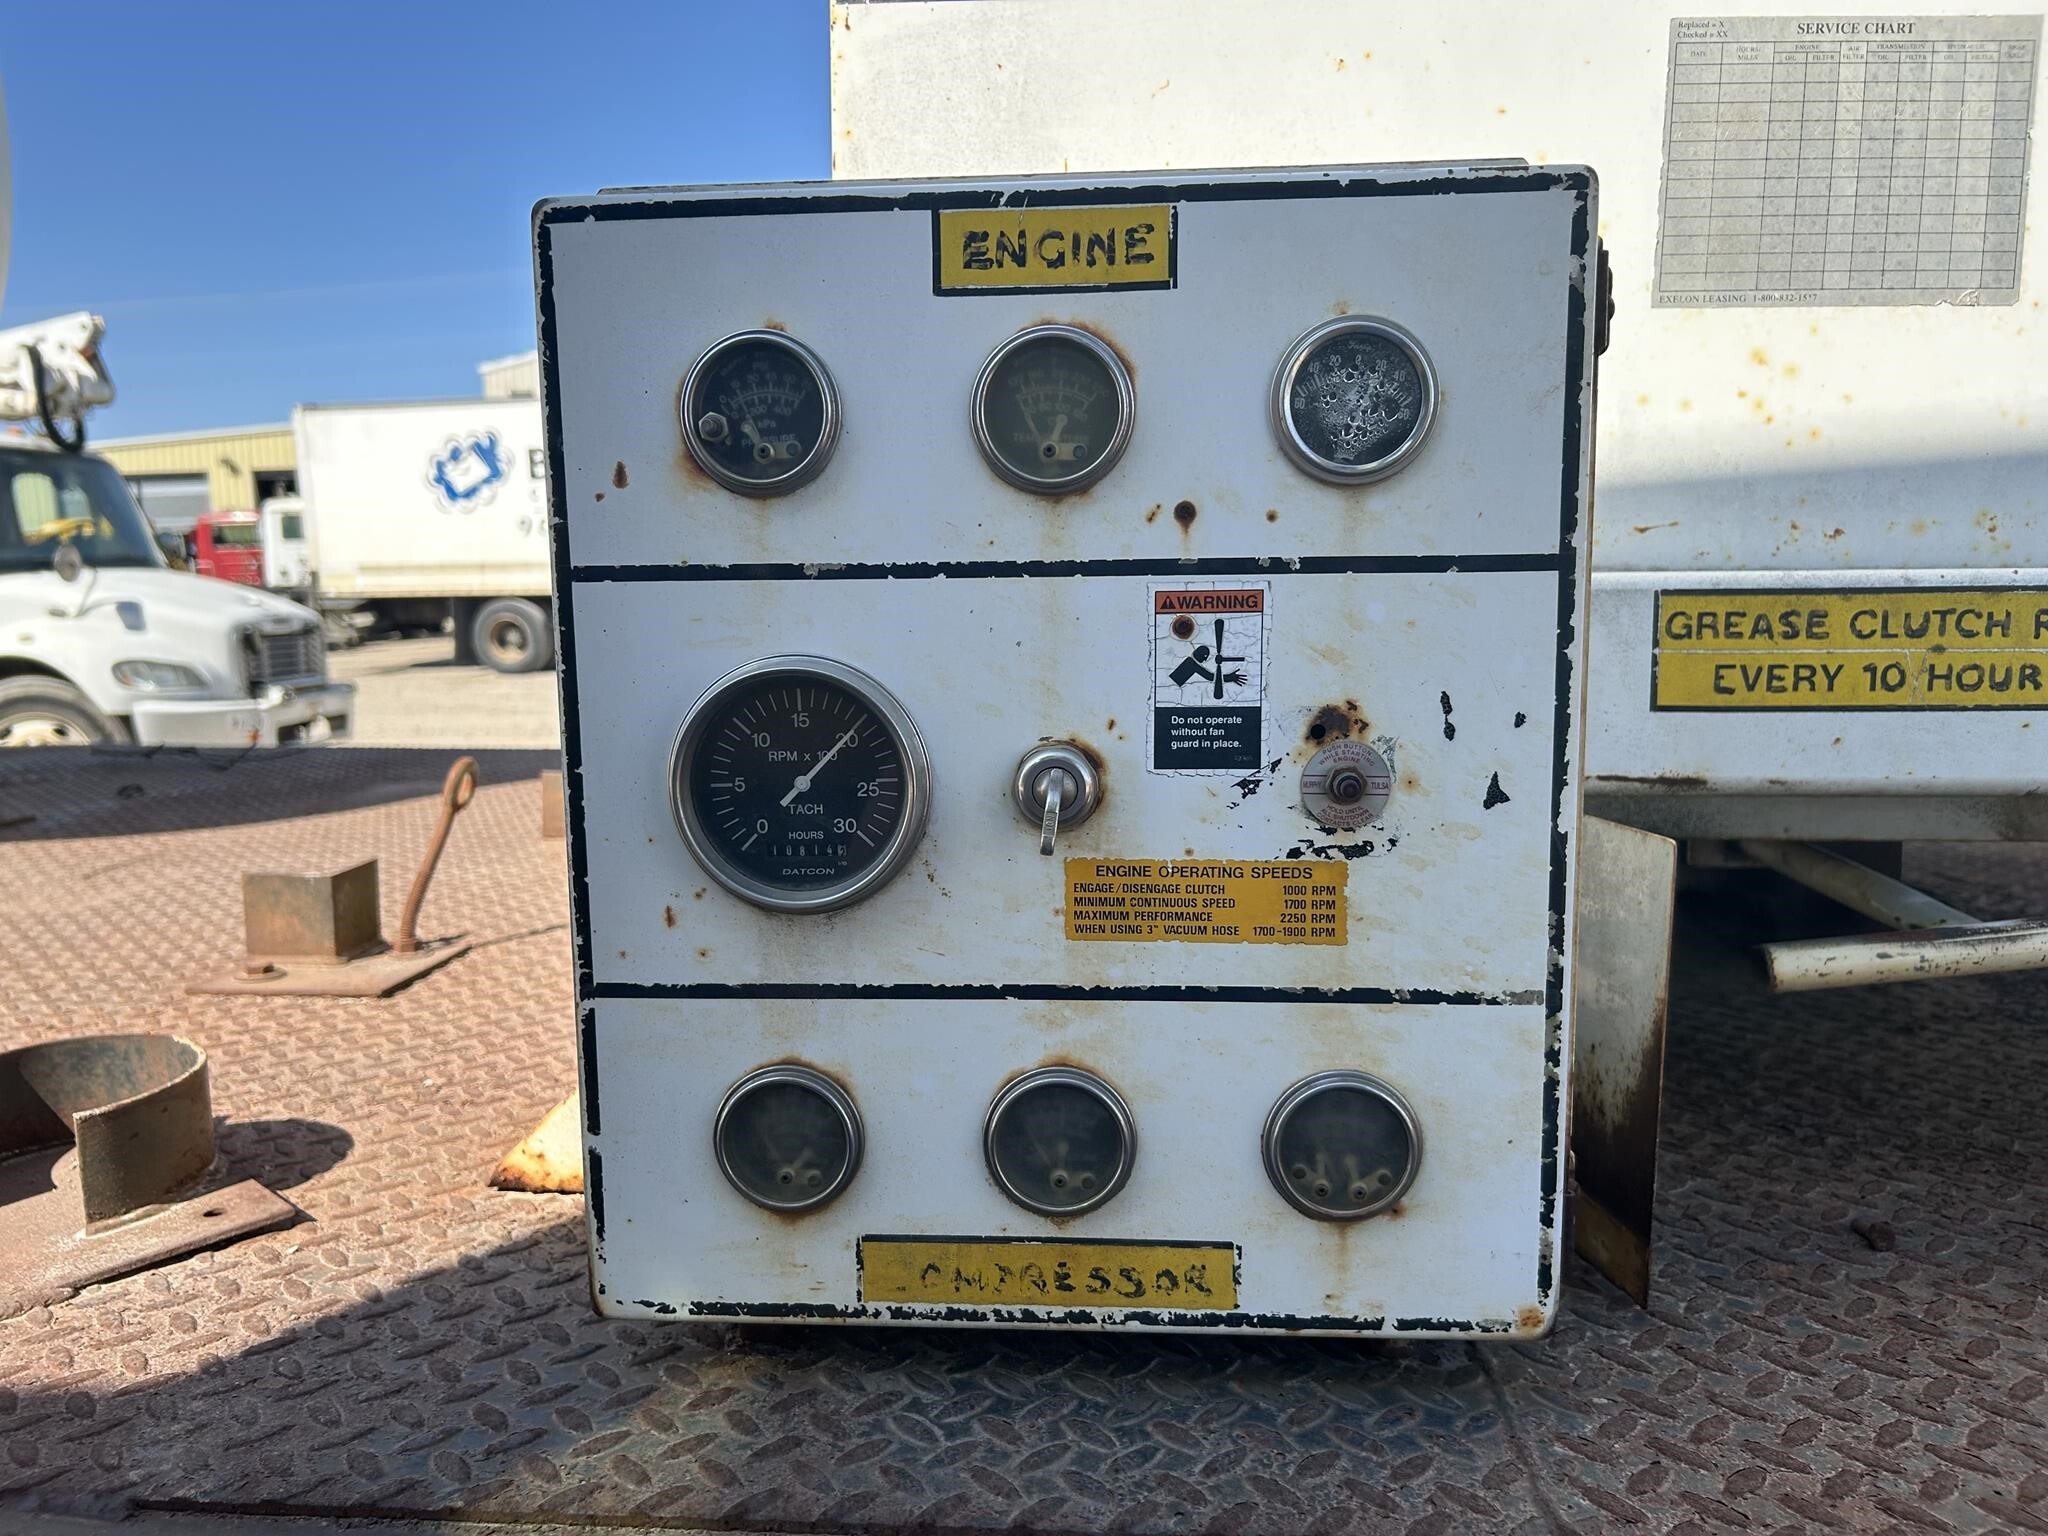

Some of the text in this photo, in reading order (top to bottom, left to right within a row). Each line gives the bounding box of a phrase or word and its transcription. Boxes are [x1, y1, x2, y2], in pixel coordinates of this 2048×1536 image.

[1678, 21, 1710, 30] Replaced
[1797, 22, 1916, 35] SERVICE CHART
[1716, 30, 1728, 38] XX
[962, 223, 1155, 270] ENGINE
[1659, 295, 1700, 304] EXELON
[1703, 294, 1746, 303] LEASING
[1329, 354, 1342, 366] 20
[1376, 359, 1388, 371] 20
[1177, 594, 1258, 609] WARNING
[1664, 608, 1830, 640] GREASE
[1849, 608, 2012, 639] CLUTCH
[1712, 664, 1844, 695] EVERY
[1862, 662, 1907, 692] 10
[790, 712, 810, 728] 15
[1171, 716, 1242, 726] Do not operate
[1171, 728, 1224, 736] without fan
[752, 732, 770, 748] 10
[835, 732, 858, 748] 20
[1171, 740, 1242, 750] guard in place.
[768, 750, 798, 762] RPM
[816, 750, 838, 762] 100
[1322, 745, 1341, 755] PUSH
[1344, 744, 1372, 756] BUTTON
[1318, 751, 1339, 766] WHILE
[1334, 756, 1360, 764] ENGINE
[1342, 750, 1376, 766] STARTING
[734, 778, 746, 792] 5
[856, 782, 880, 797] 25
[1371, 782, 1388, 790] TULSA
[788, 804, 824, 814] TACH
[1327, 806, 1344, 814] HOLD
[1334, 808, 1370, 820] SHUTDOWN
[833, 818, 857, 833] 30
[1316, 812, 1350, 826] CONTACTS
[1352, 813, 1374, 826] CLEAR
[756, 819, 769, 834] 0
[788, 831, 824, 840] HOURS
[782, 868, 835, 876] DATCON
[1096, 865, 1314, 880] ENGINE OPERATING SPEEDS
[1074, 883, 1336, 896] ENGAGE/DISENGAGE CLUTCH 1000 RPM
[1074, 897, 1336, 910] MINIMUM CONTINUOUS SPEED 1700 RPM
[1074, 910, 1336, 924] MAXIMUM PERFORMANCE 2250 RPM
[1074, 924, 1106, 935] WHEN
[1110, 924, 1142, 935] USING
[1164, 925, 1208, 936] VACUUM
[1212, 926, 1240, 936] HOSE
[1252, 926, 1306, 937] 1700-1900
[1312, 926, 1336, 938] RPM
